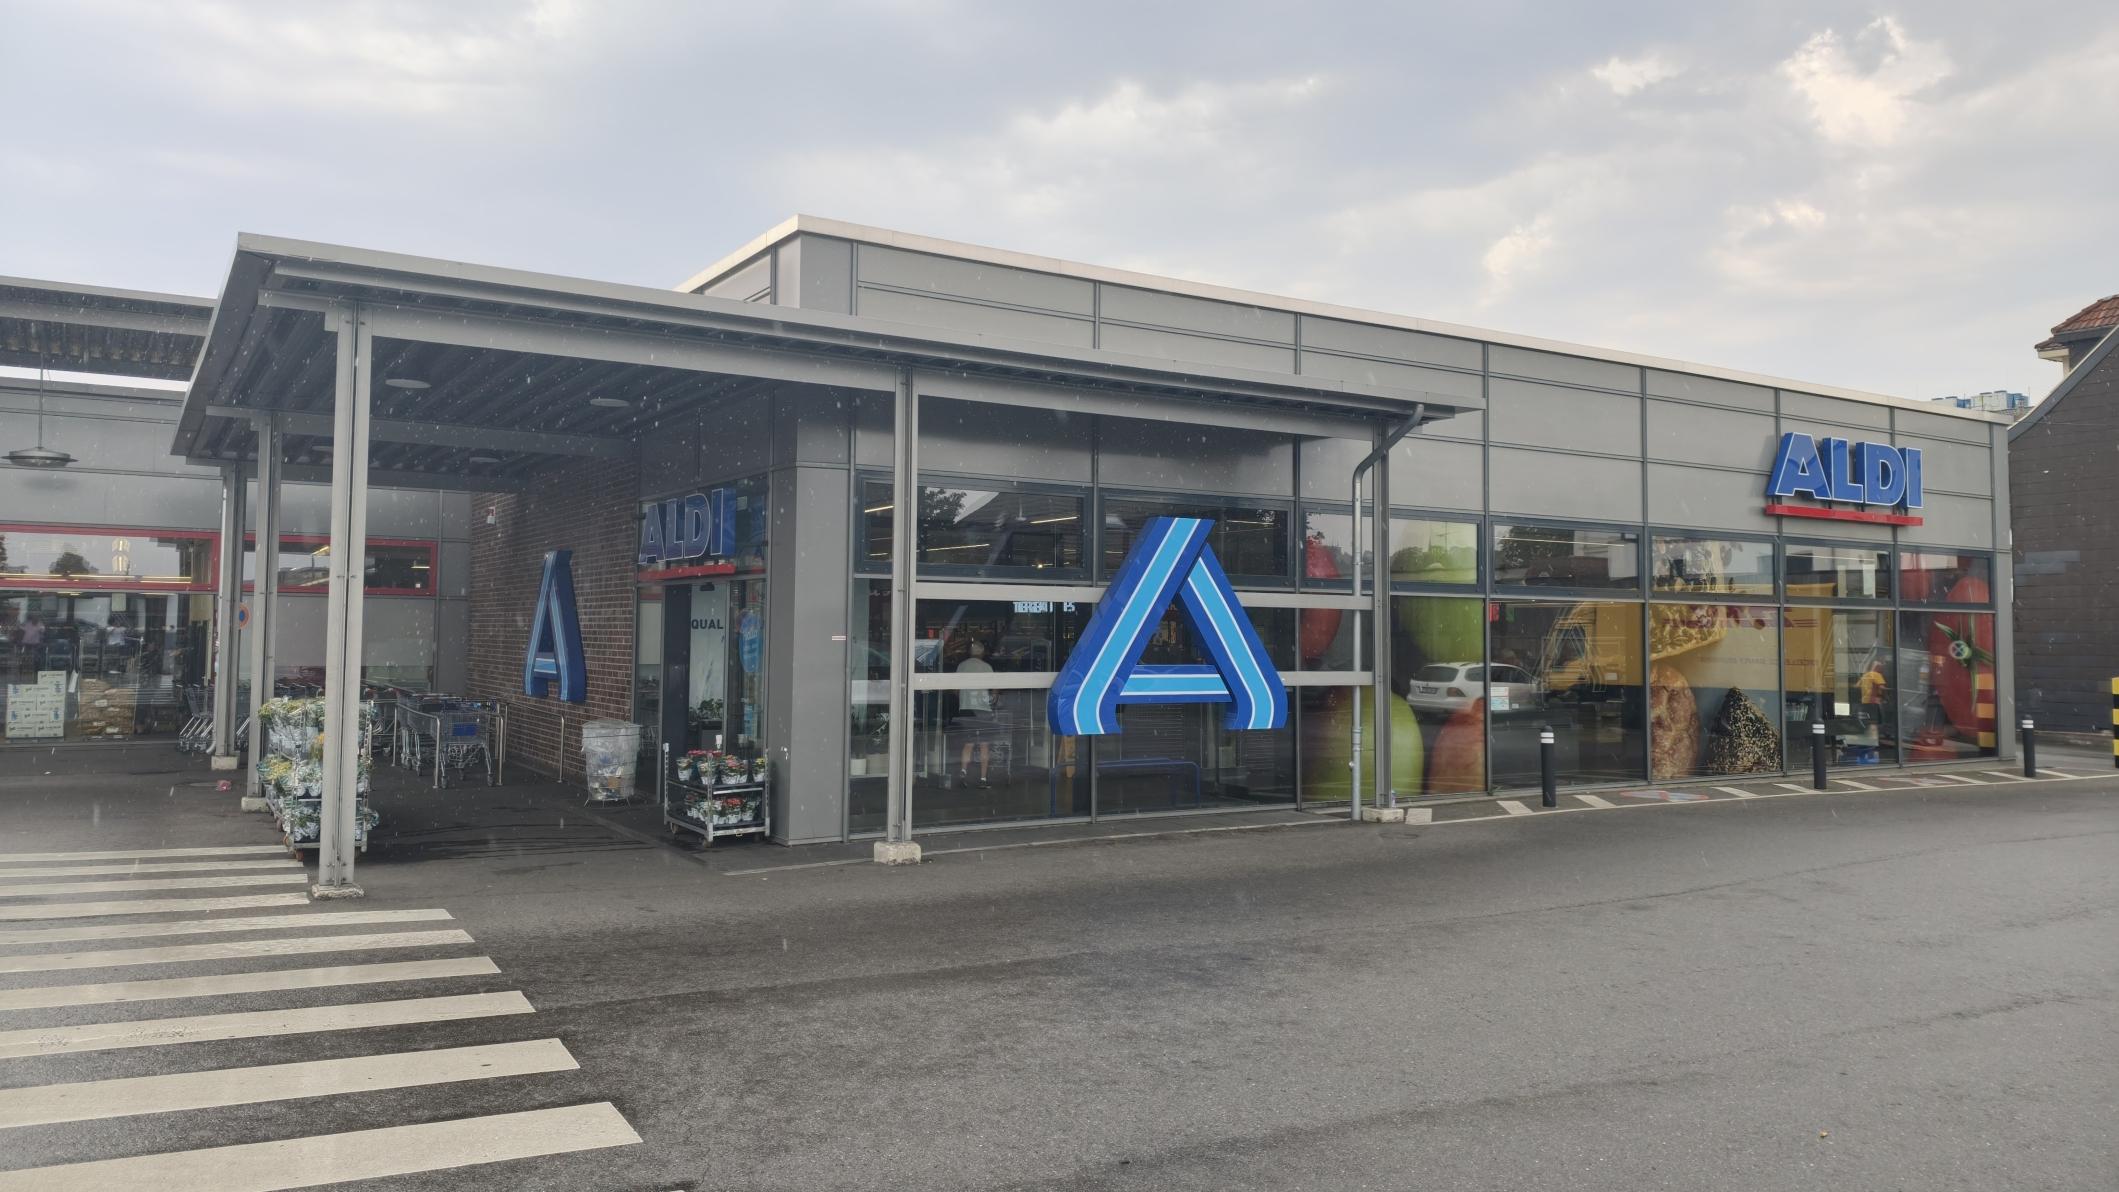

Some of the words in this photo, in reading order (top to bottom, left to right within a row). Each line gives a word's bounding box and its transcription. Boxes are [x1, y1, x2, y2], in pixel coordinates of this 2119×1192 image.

[1767, 432, 1923, 508] ALDI
[639, 487, 736, 564] ALDI
[691, 618, 724, 630] QUAL
